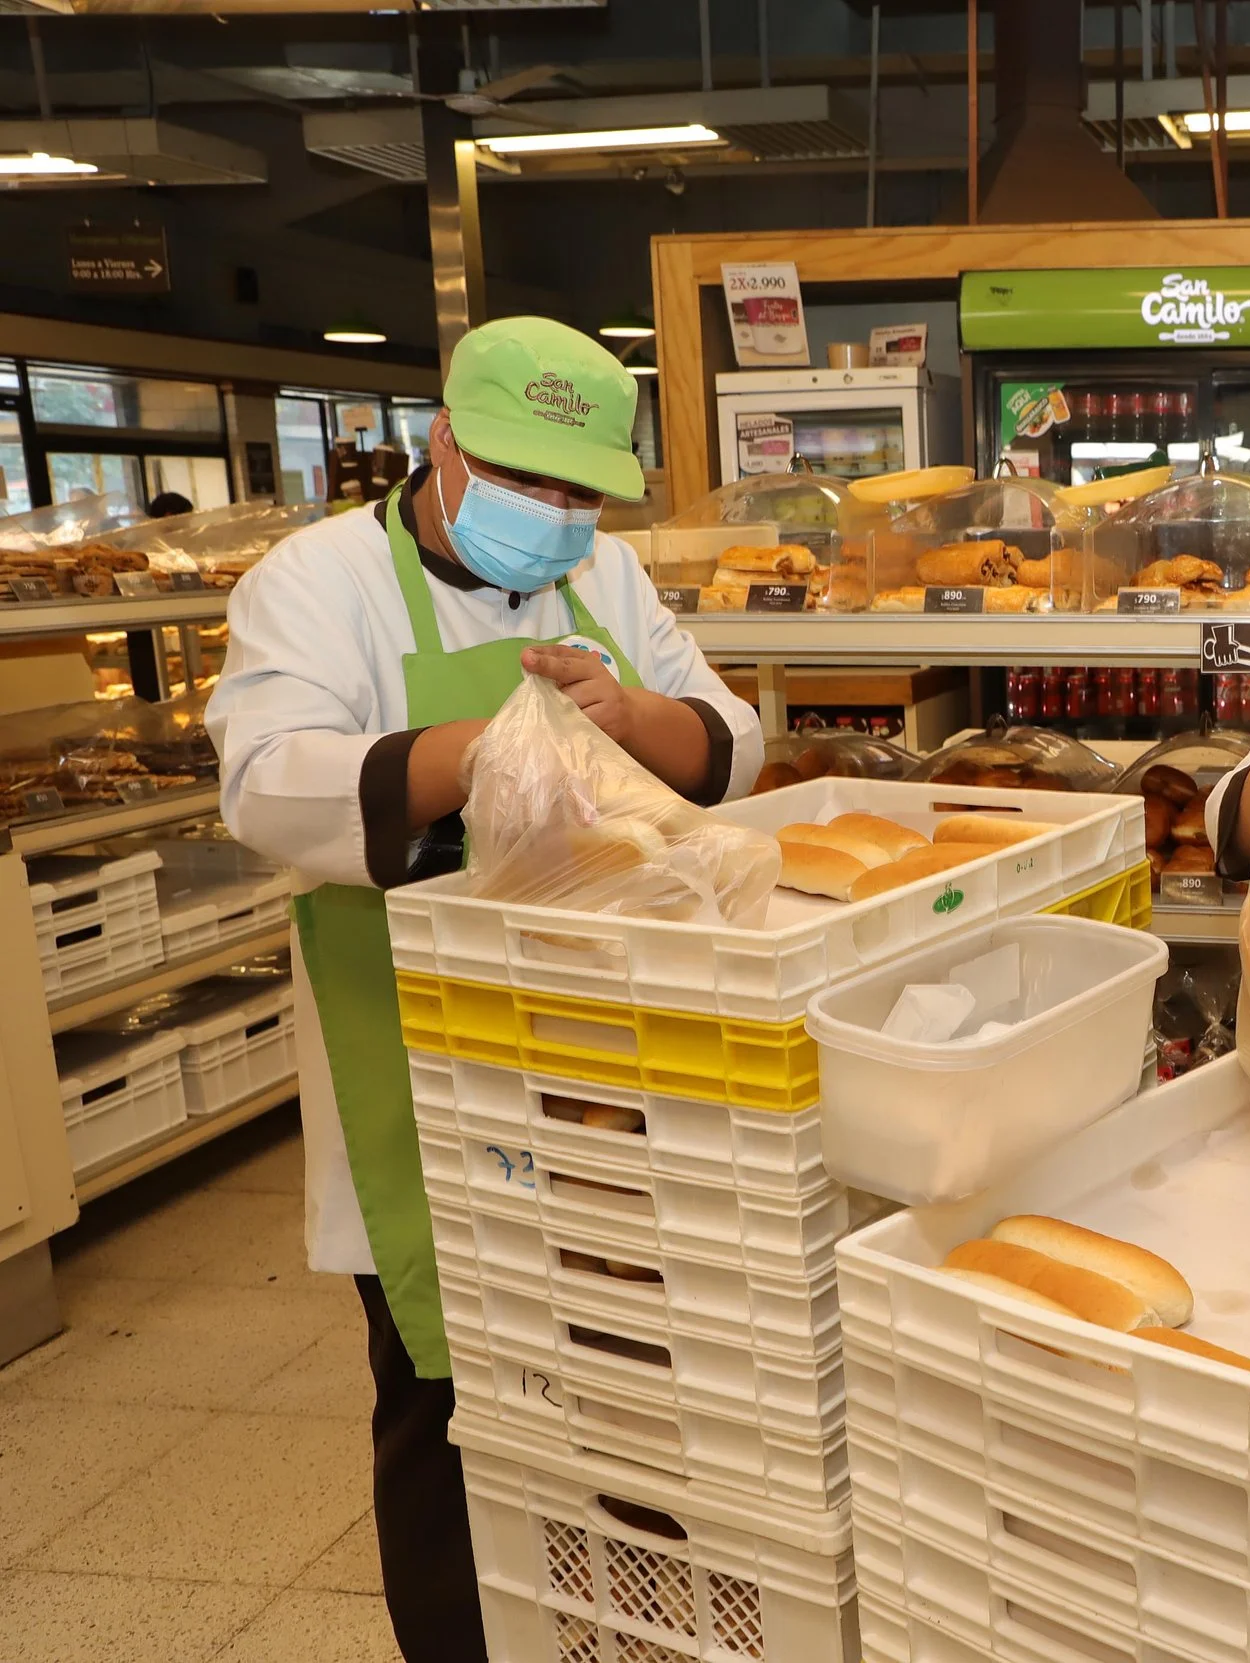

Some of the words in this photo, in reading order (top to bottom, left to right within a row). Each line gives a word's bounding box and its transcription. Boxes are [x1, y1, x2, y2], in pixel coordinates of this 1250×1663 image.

[1162, 273, 1210, 301] San
[540, 372, 575, 393] San
[524, 381, 600, 416] Camilo
[522, 1367, 563, 1409] 12
